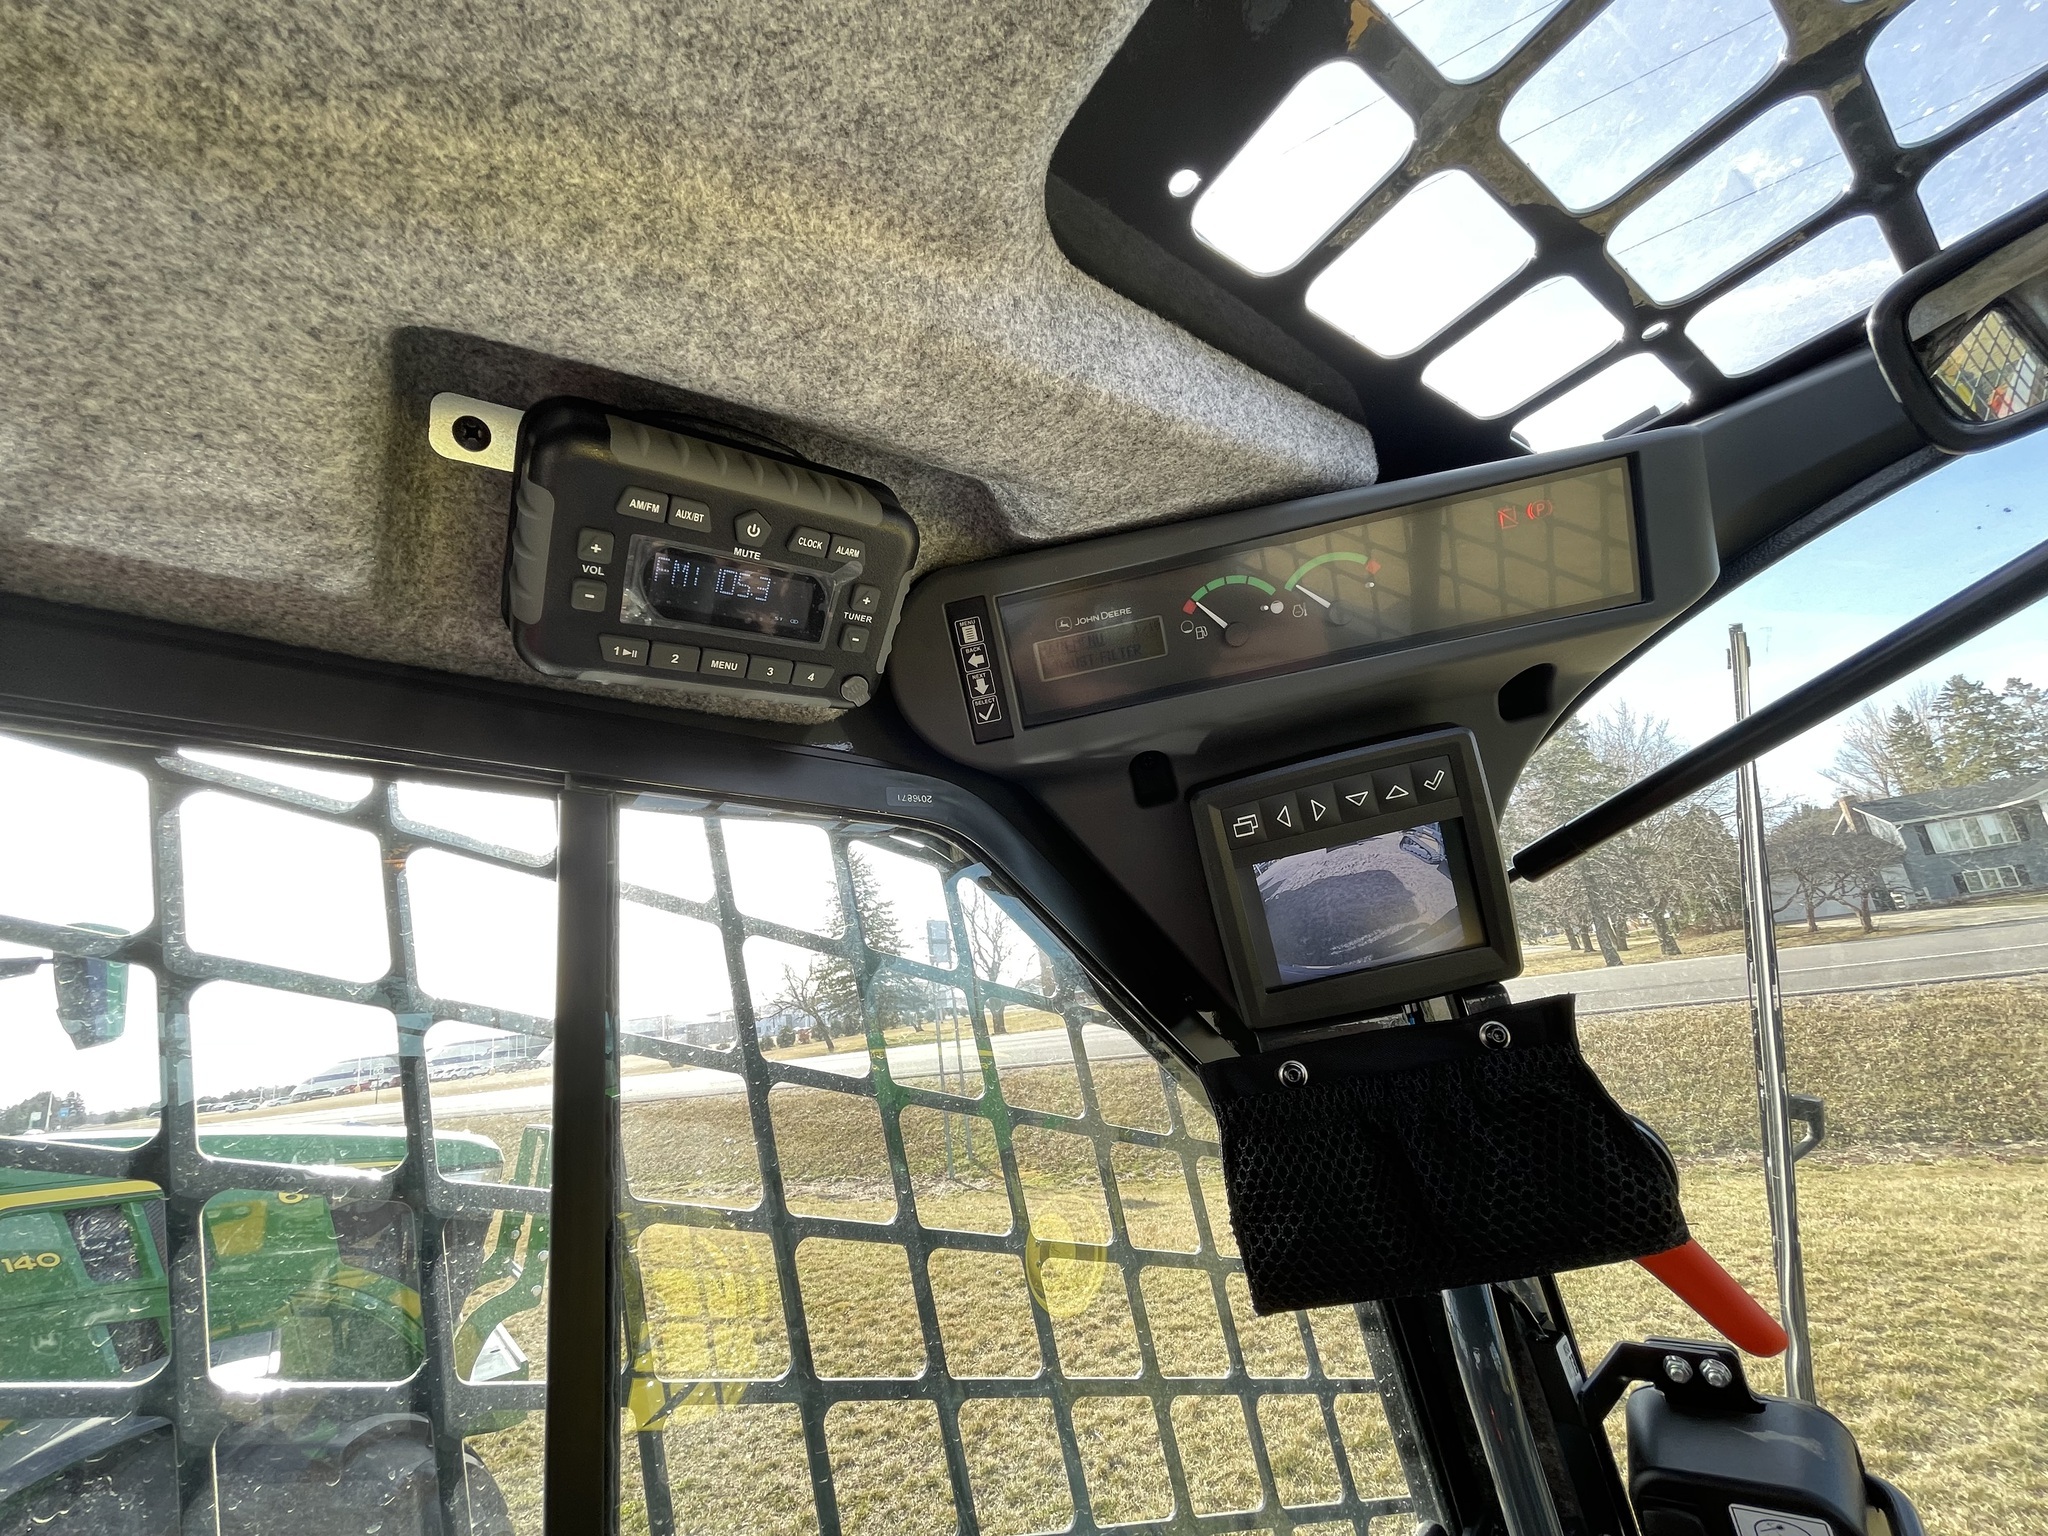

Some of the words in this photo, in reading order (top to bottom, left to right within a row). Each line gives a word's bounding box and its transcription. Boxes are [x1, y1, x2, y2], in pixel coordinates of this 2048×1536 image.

[628, 499, 660, 514] AM/FM
[675, 508, 705, 522] AUX/BT
[798, 537, 823, 550] CLOCK
[733, 547, 761, 560] MUTE
[836, 545, 860, 558] ALARM
[582, 564, 605, 576] VOL
[715, 568, 772, 601] 105.3
[843, 611, 873, 624] TUNER
[1074, 614, 1100, 626] JOHN
[1100, 607, 1132, 621] DEERE
[613, 646, 621, 656] 1
[965, 646, 981, 654] BACK
[670, 654, 680, 664] 2
[710, 660, 738, 671] MENU
[766, 667, 774, 676] 3
[807, 672, 815, 682] 4
[971, 672, 986, 680] NEXT
[975, 698, 996, 706] SELECT
[1, 1252, 61, 1272] 140
